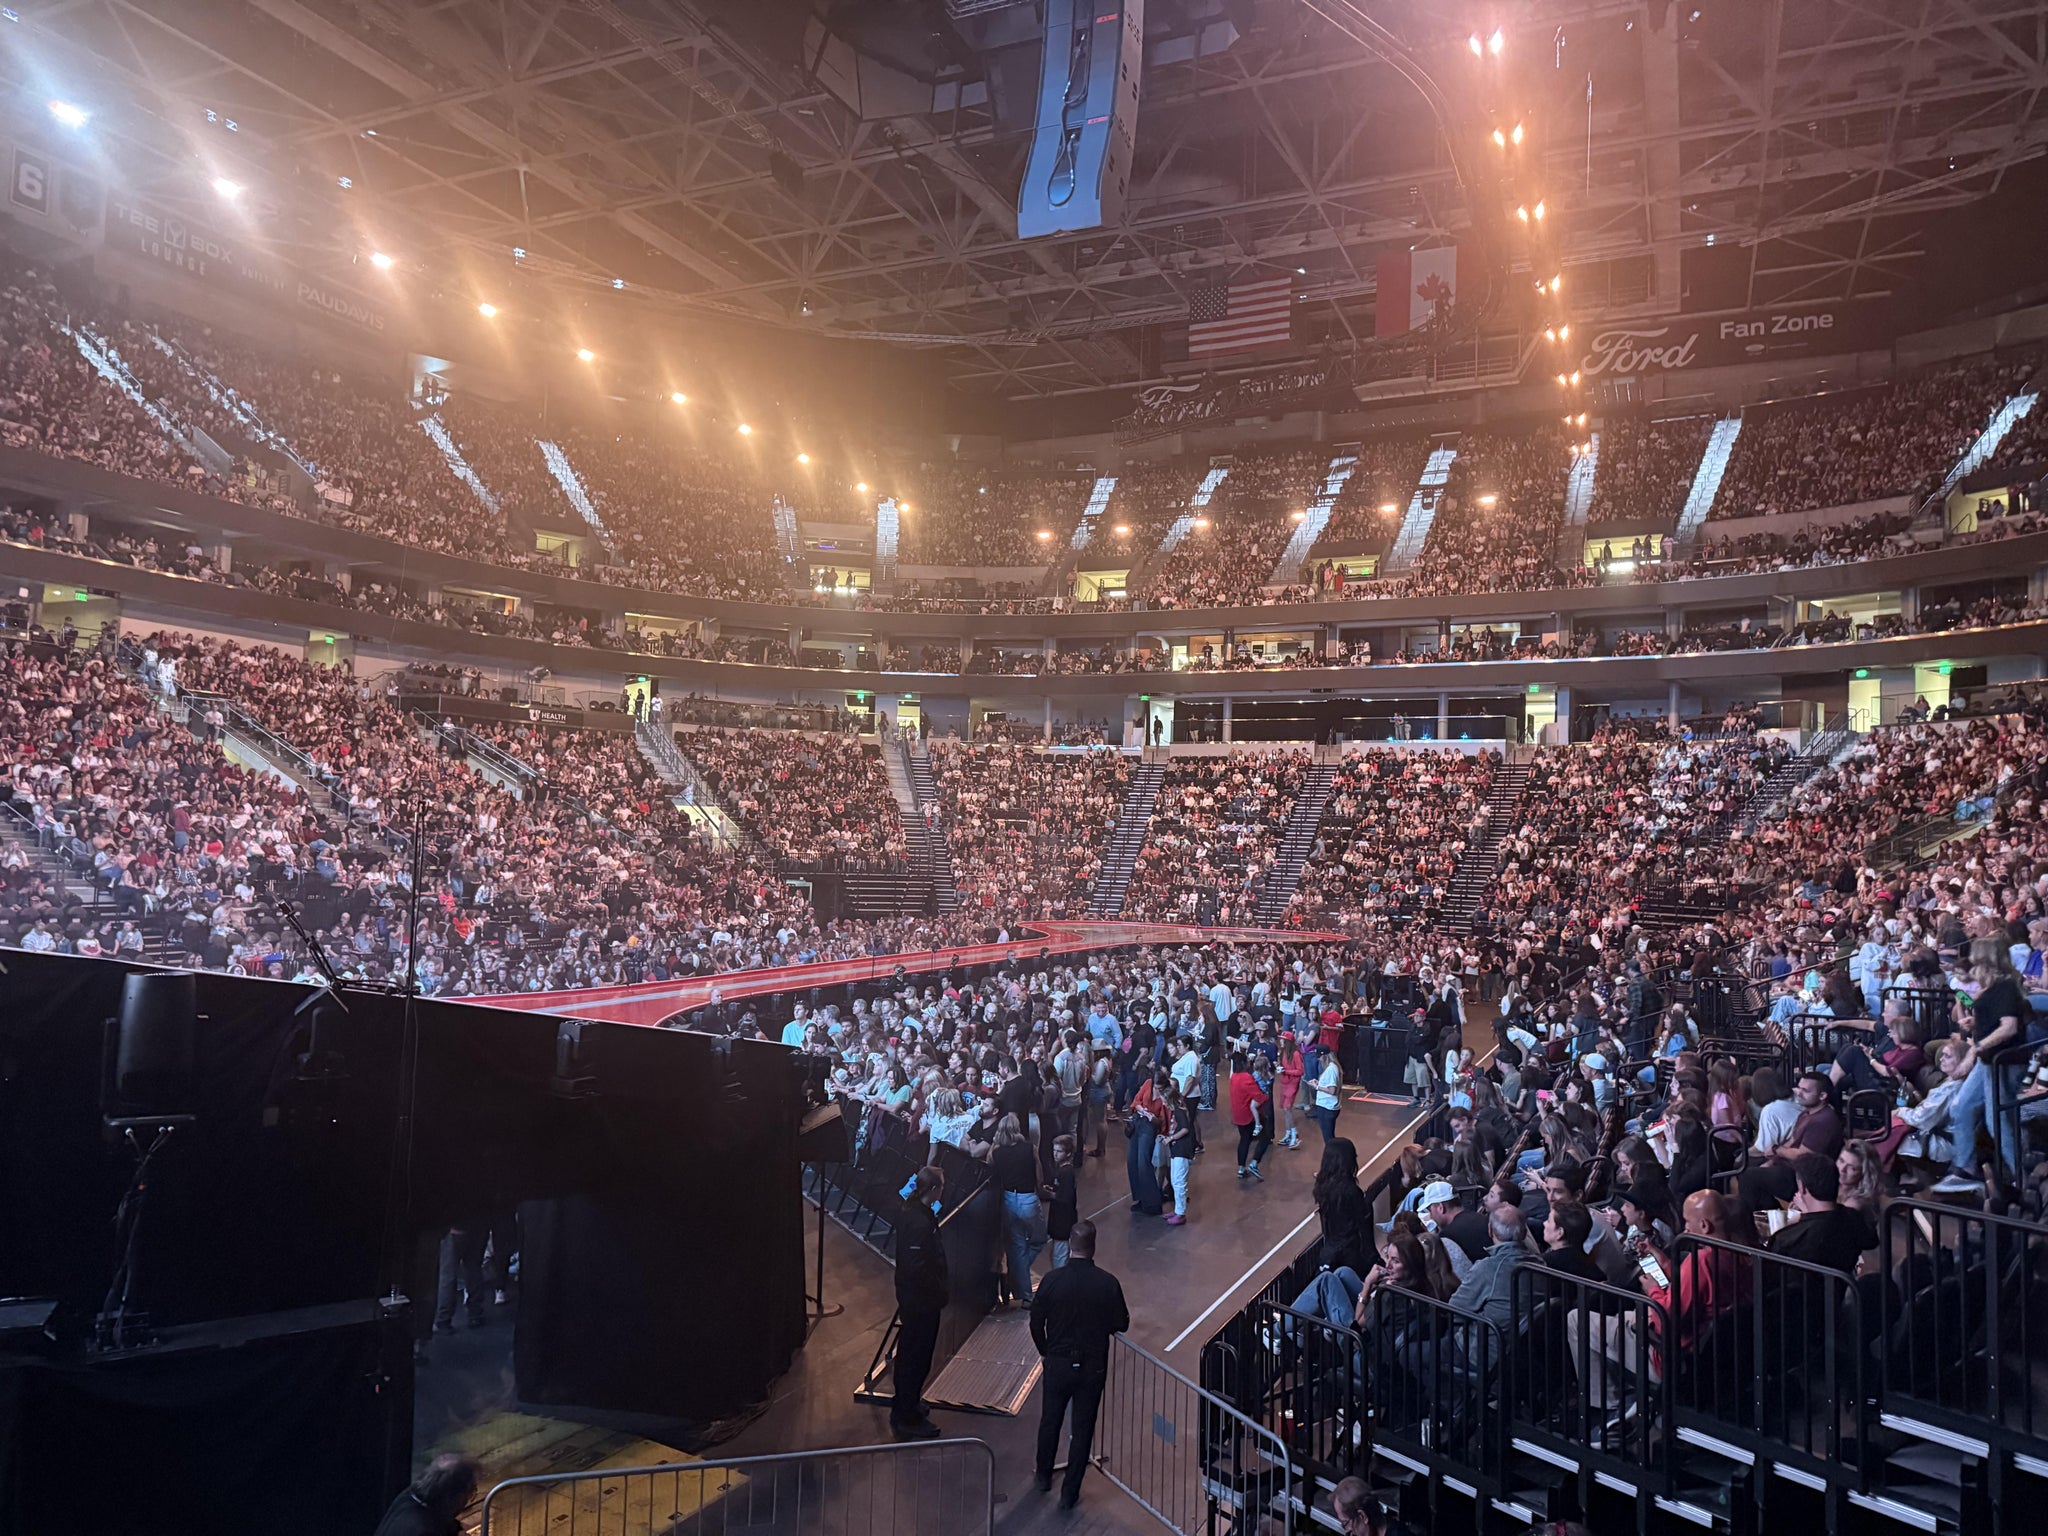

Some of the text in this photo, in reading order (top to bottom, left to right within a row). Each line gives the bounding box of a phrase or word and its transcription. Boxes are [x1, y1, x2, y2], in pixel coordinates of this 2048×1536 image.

[18, 162, 44, 200] 6
[114, 203, 159, 234] TEE
[190, 234, 233, 264] BOX
[140, 237, 207, 276] LOUNGE
[1581, 313, 1834, 375] Ford Fan Zone
[541, 712, 566, 720] HEALTH
